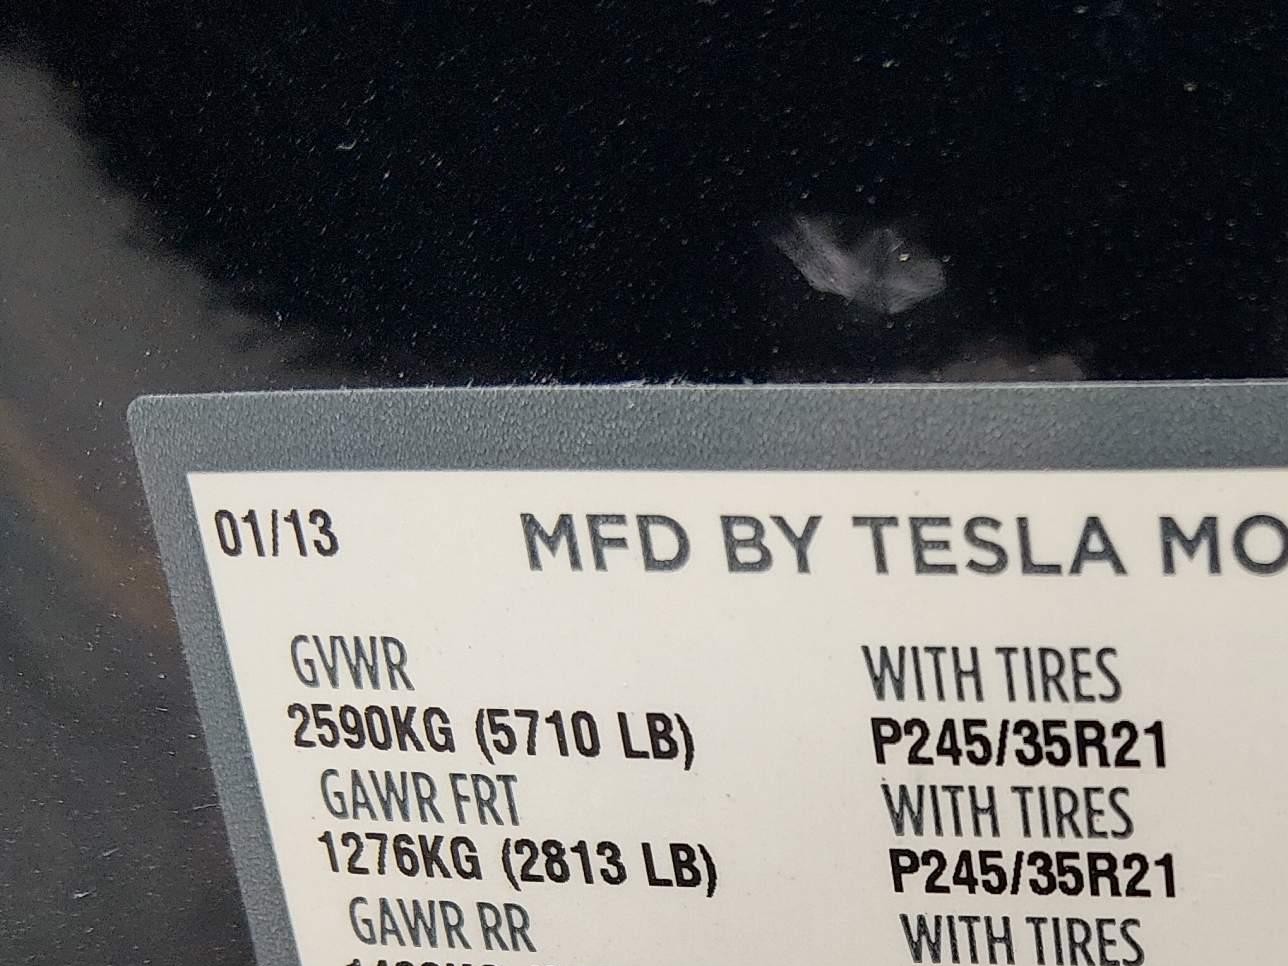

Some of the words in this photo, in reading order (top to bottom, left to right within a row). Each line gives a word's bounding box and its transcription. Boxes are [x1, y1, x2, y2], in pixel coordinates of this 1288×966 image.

[214, 508, 339, 558] 01/13
[519, 512, 691, 572] MFD
[719, 514, 823, 574] BY
[851, 515, 1128, 576] TESLA
[290, 634, 415, 691] GVWR
[860, 644, 985, 703] WITH
[994, 646, 1123, 704] TIRES
[286, 702, 456, 754] 2590KG
[474, 708, 601, 766] (5710
[616, 711, 695, 772] LB)
[870, 716, 1167, 769] P245/35R21
[320, 768, 445, 824] GAWR
[448, 772, 520, 827] FRT
[880, 783, 1001, 838] WITH
[1010, 785, 1135, 841] TIRES
[317, 830, 483, 881] 1276KG
[501, 837, 628, 892] (2813
[640, 841, 718, 899] LB)
[888, 847, 1177, 899] P245/35R21
[348, 896, 473, 950] GAWR
[475, 901, 537, 953] RR
[898, 913, 1016, 966] WITH
